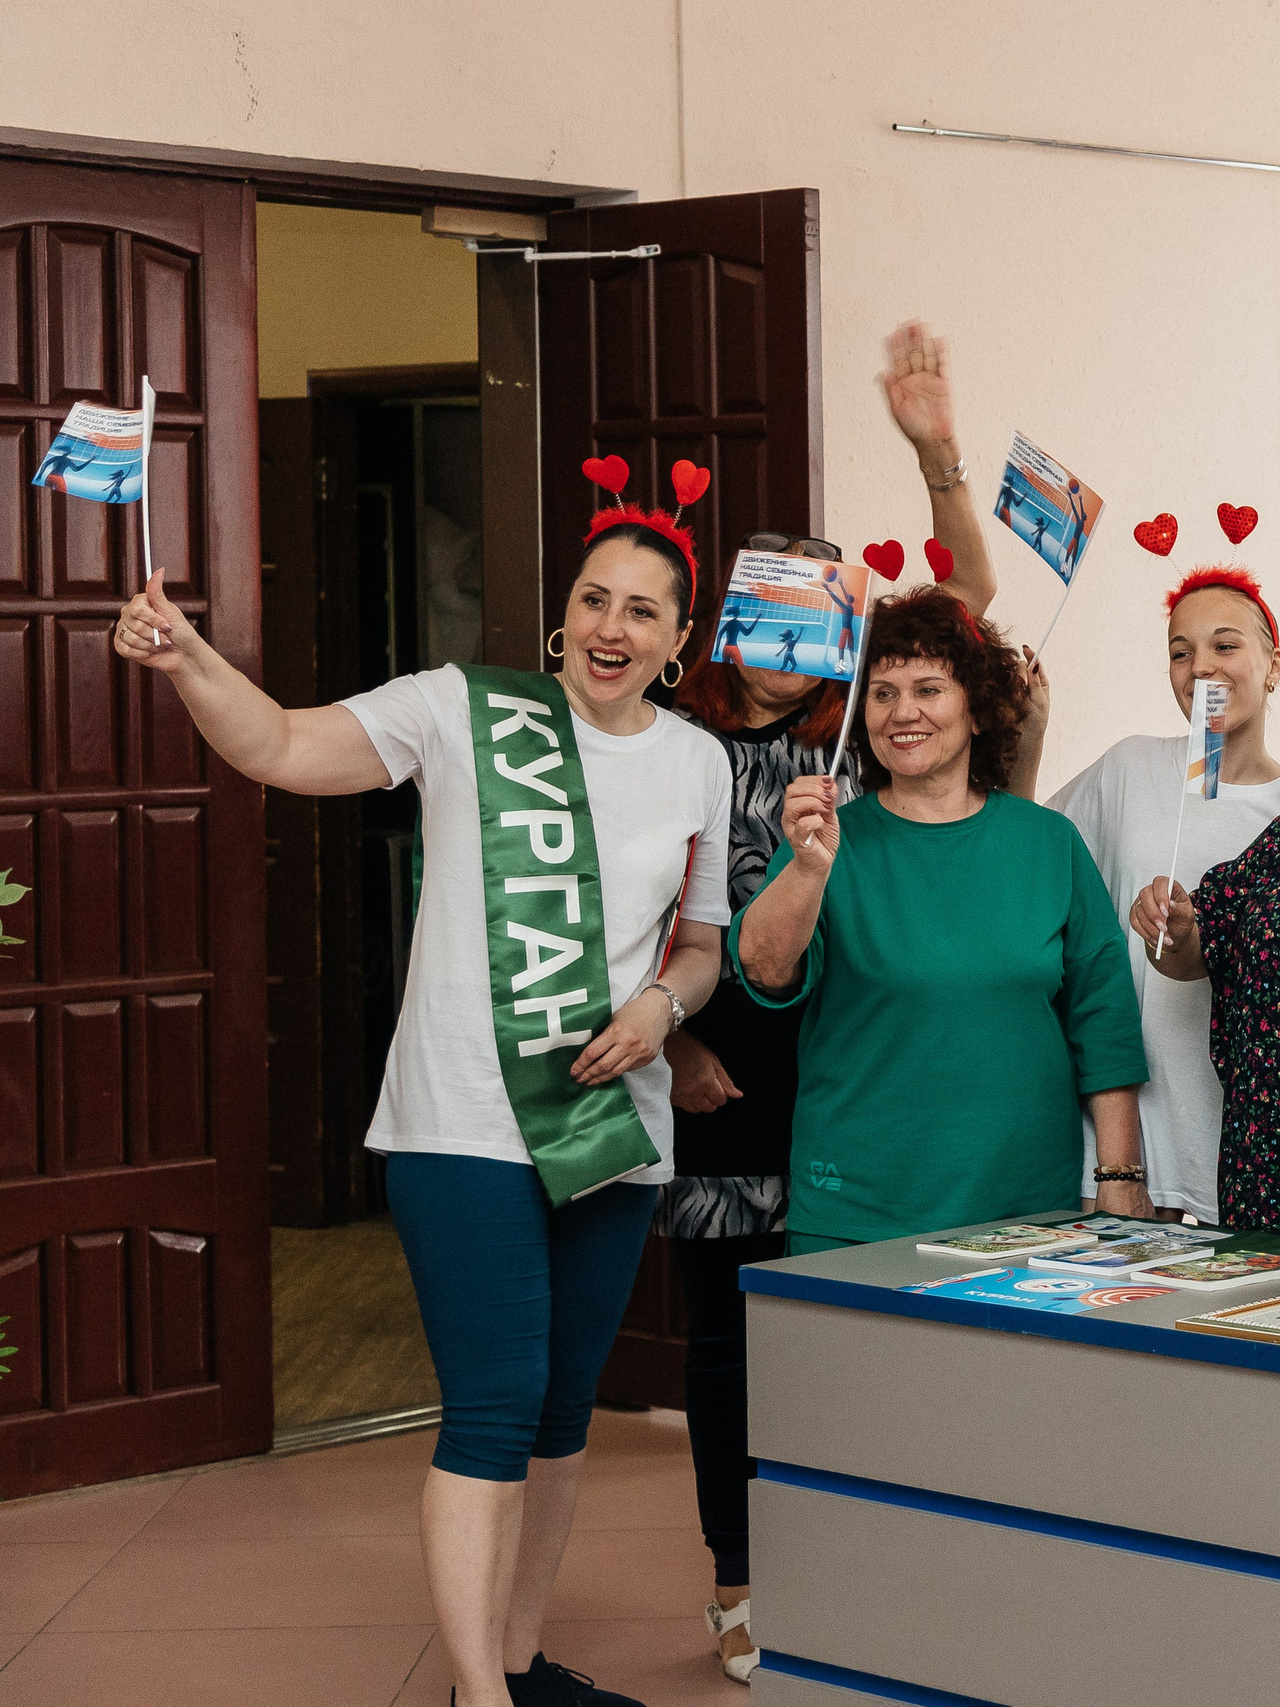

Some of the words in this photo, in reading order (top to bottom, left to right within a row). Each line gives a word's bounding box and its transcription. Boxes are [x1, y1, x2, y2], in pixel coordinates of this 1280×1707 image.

[75, 414, 104, 426] НАША
[738, 571, 783, 582] ТРАДИЦИЯ
[740, 564, 765, 573] НАША
[765, 566, 814, 579] СЕМЕЙНАЯ
[488, 693, 593, 1058] КУРГАН
